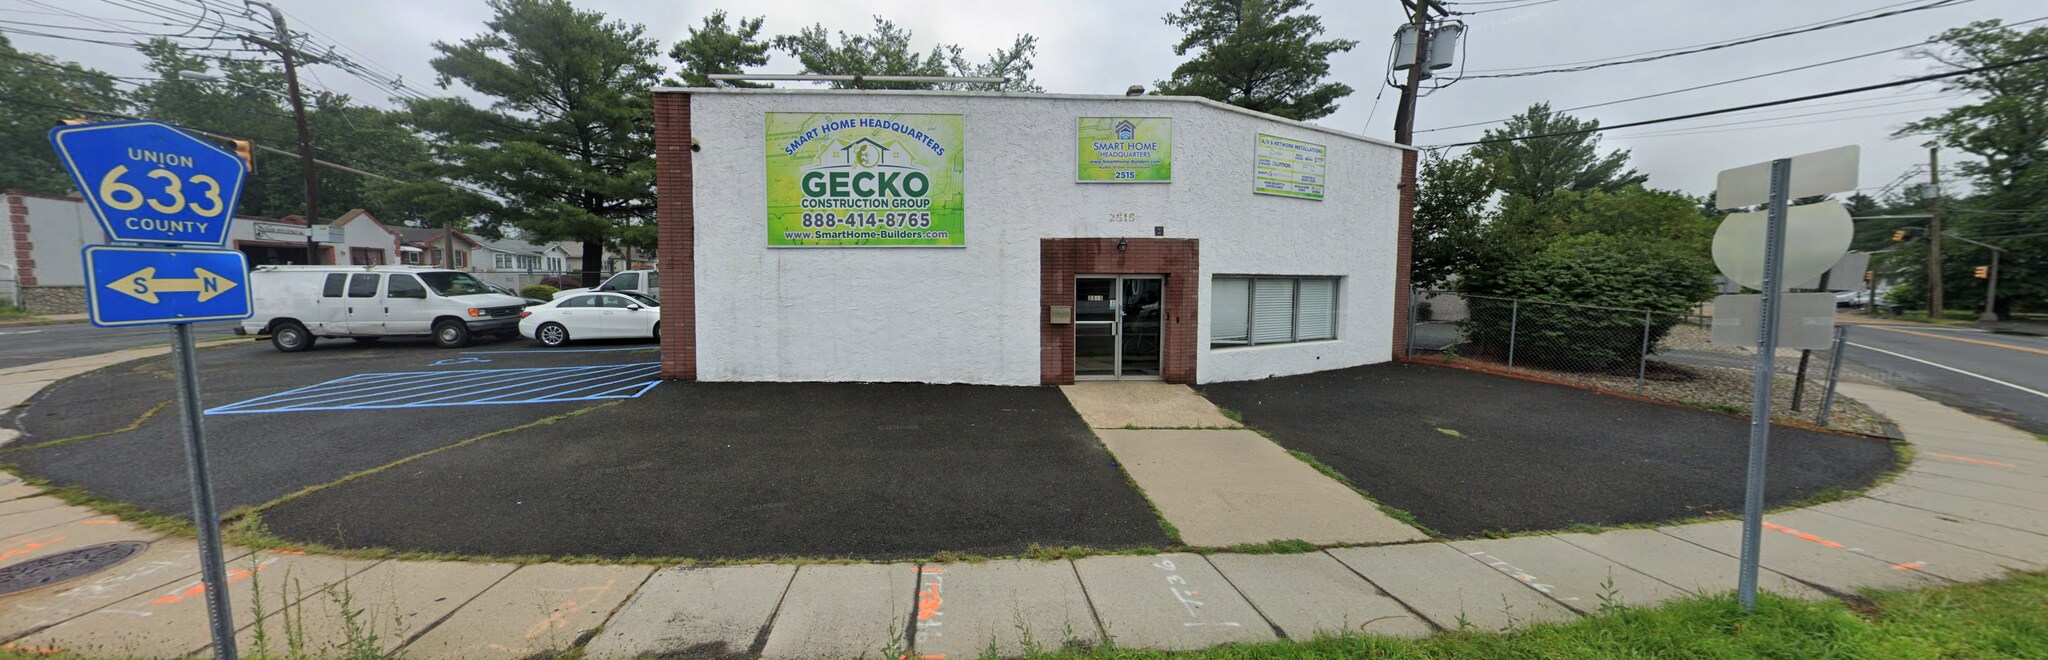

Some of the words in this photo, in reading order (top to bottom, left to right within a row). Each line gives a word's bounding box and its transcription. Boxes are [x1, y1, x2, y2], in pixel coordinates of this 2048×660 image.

[785, 127, 819, 156] SMART
[821, 118, 856, 134] HOME
[860, 118, 945, 157] HEADQUARTERS
[1093, 142, 1125, 151] SMART
[1127, 142, 1157, 151] HOME
[1294, 144, 1323, 154] INSTALLATIONS
[127, 147, 193, 168] UNION
[99, 164, 224, 217] 633
[801, 171, 930, 198] GECKO
[801, 198, 889, 208] CONSTRUCTION
[892, 198, 930, 209] GROUP
[125, 217, 209, 234] COUNTY
[802, 212, 930, 228] 888-414-8765
[1109, 213, 1135, 222] 2515
[785, 230, 948, 239] www.SmartHome-Builders.com
[133, 276, 149, 294] S
[203, 276, 218, 293] N
